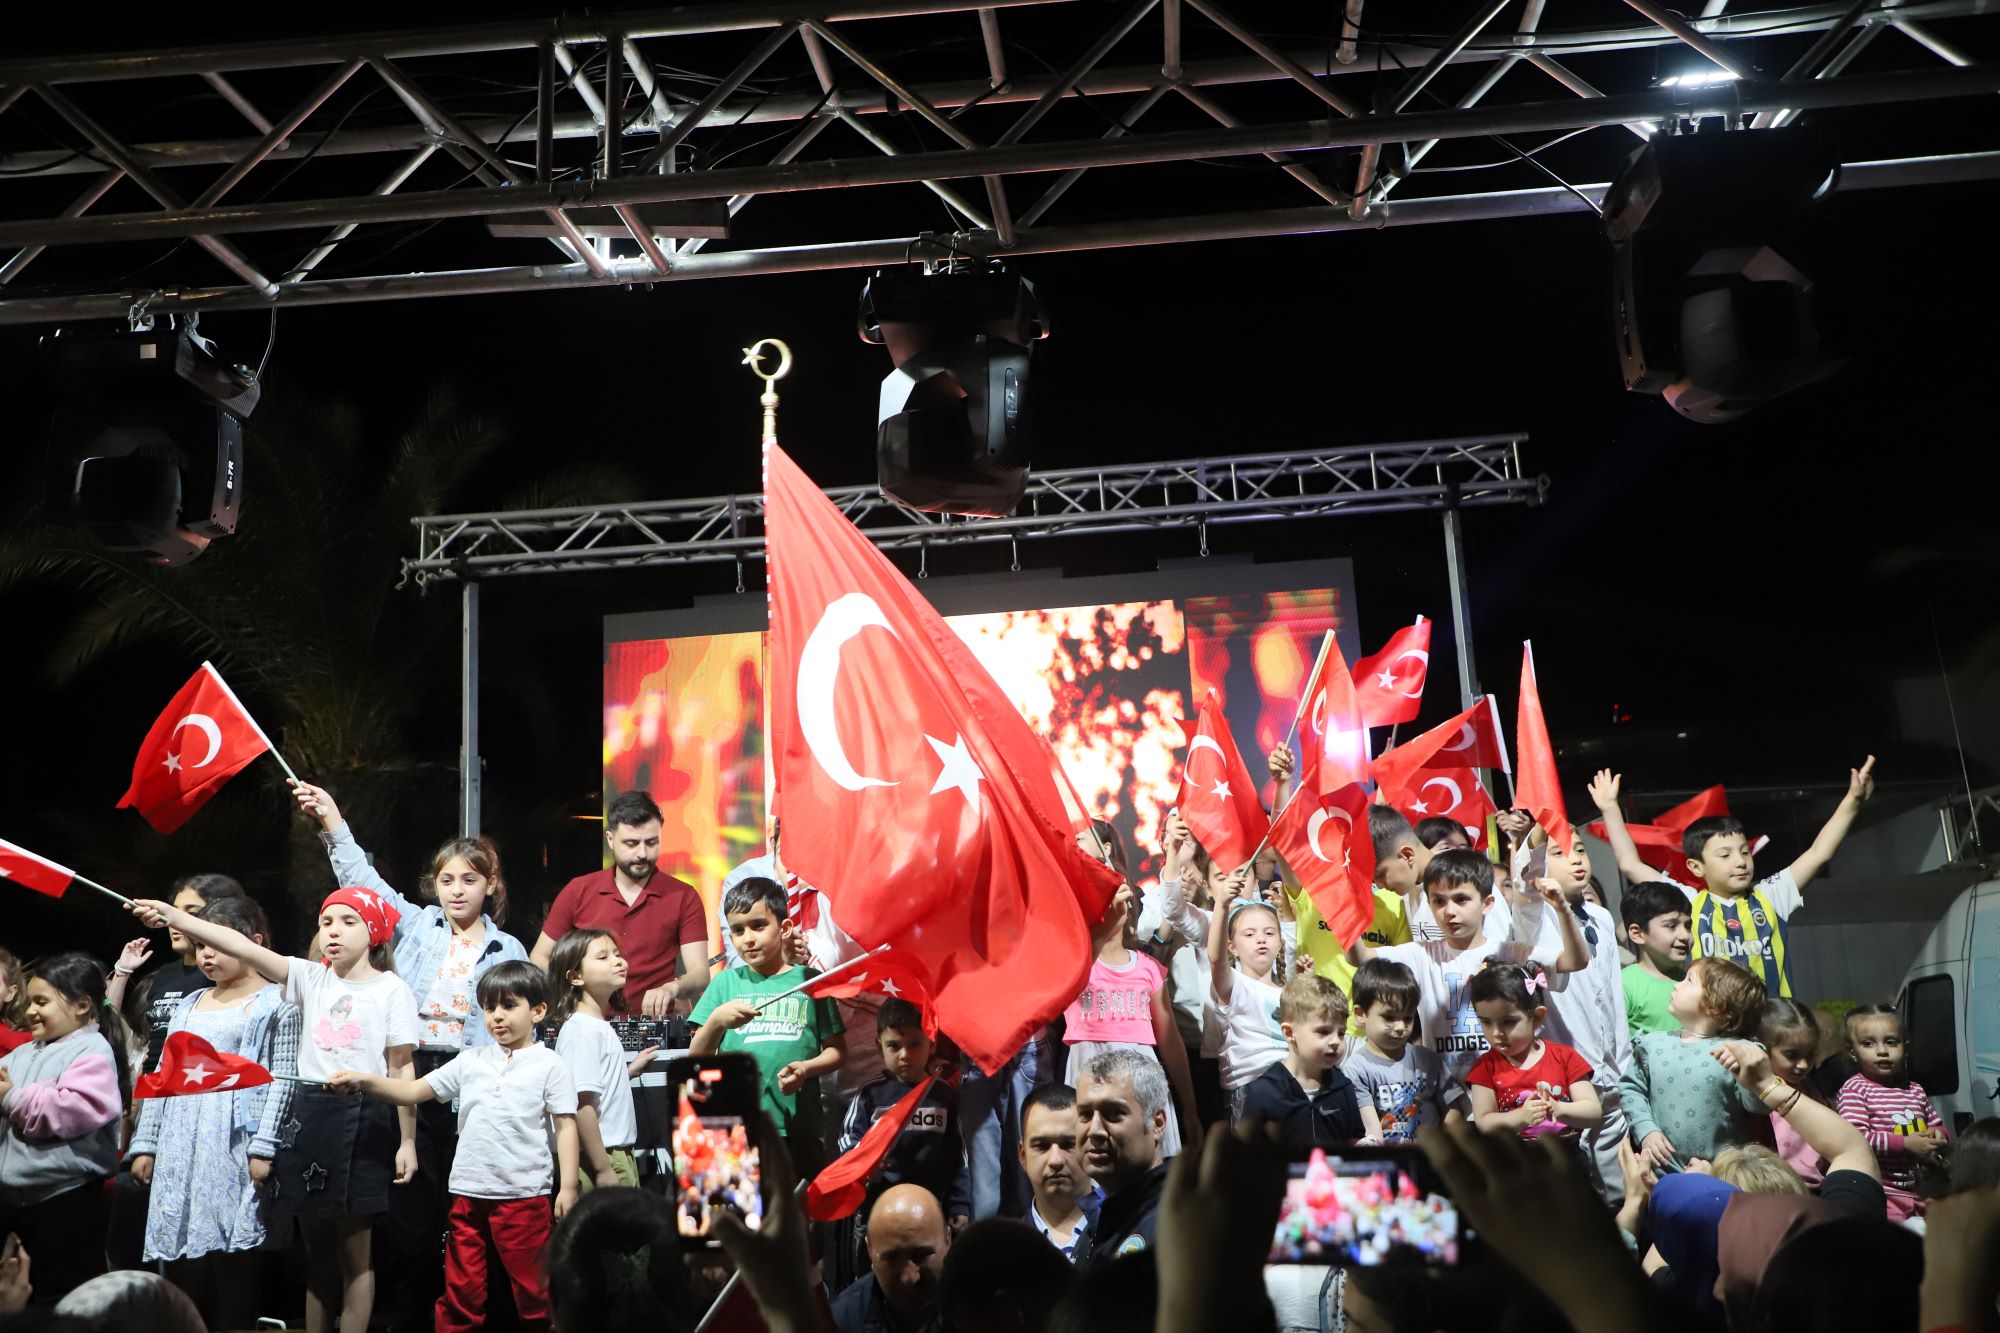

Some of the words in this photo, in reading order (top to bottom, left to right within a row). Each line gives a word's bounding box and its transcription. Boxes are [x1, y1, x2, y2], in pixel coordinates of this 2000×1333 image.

[1700, 932, 1773, 960] Otokoç
[1435, 1034, 1490, 1054] DODGE
[909, 1109, 944, 1127] das
